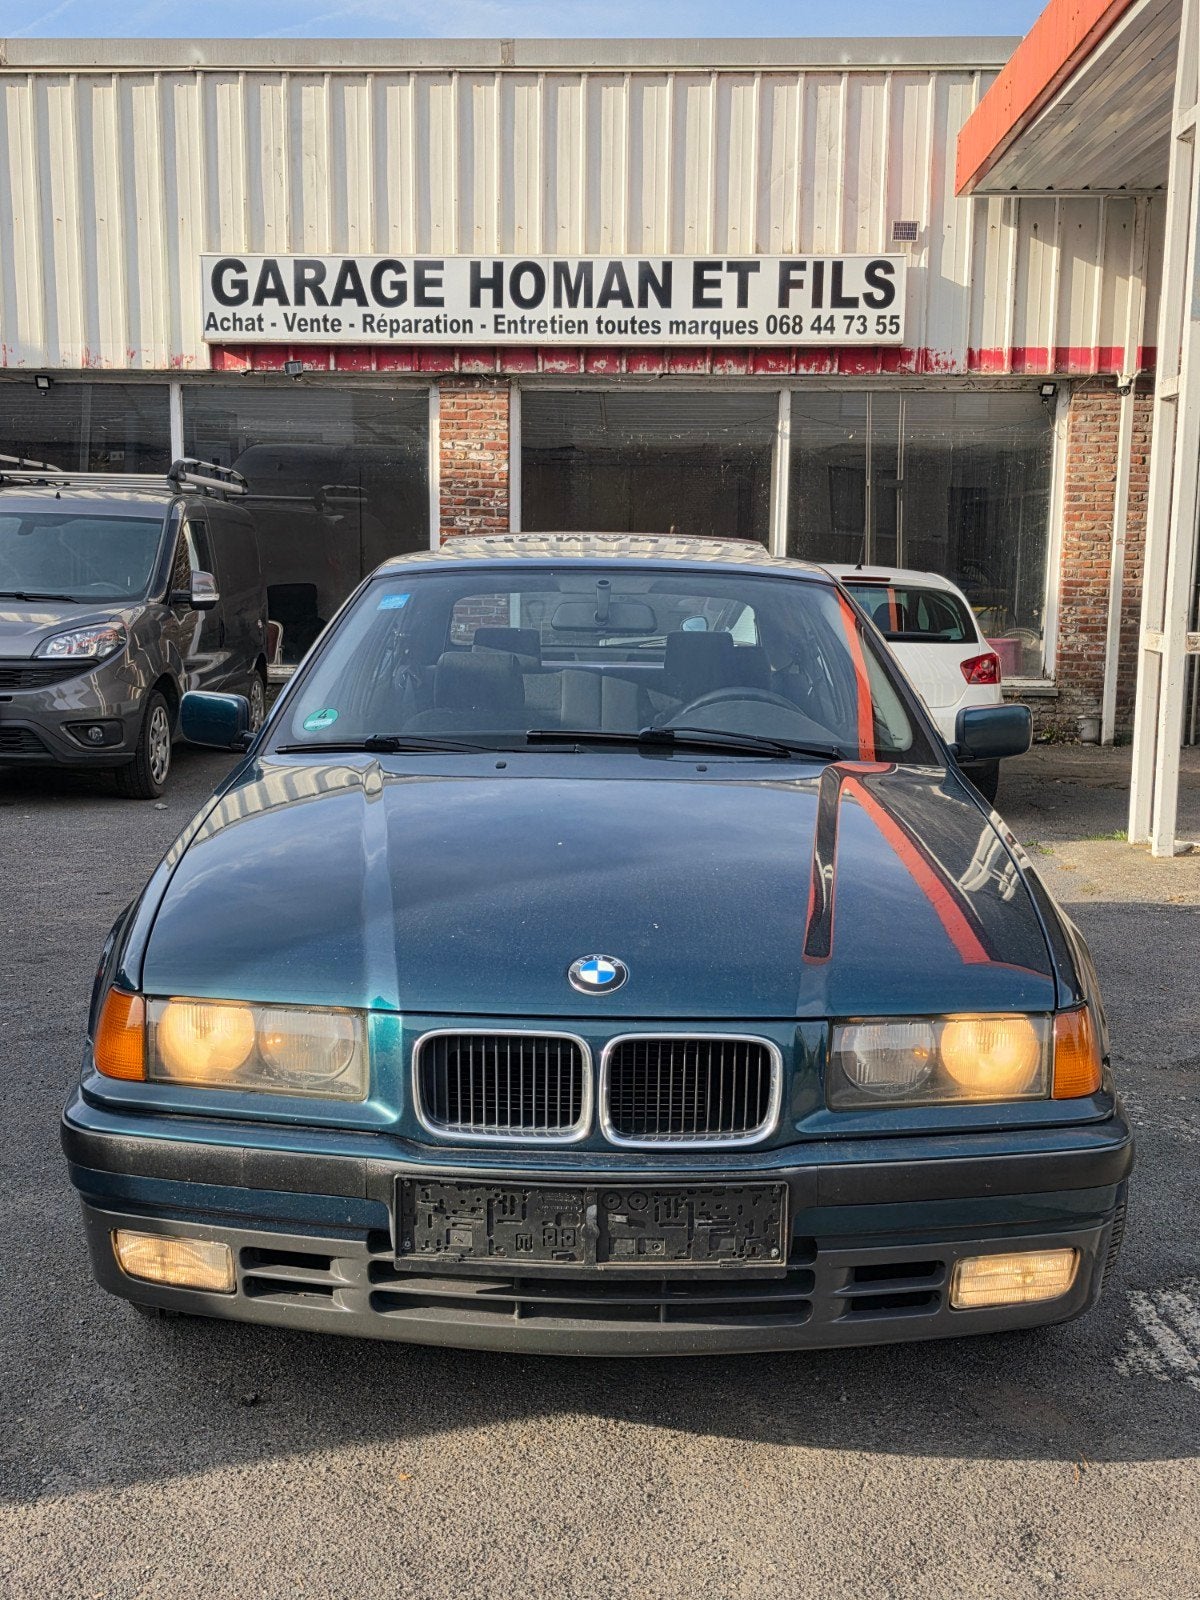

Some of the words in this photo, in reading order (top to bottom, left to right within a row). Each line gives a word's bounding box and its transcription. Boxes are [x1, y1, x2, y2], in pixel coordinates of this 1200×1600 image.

[210, 258, 445, 308] GARAGE
[469, 260, 673, 310] HOMAN
[692, 260, 761, 309] ET
[777, 259, 896, 310] FILS
[204, 311, 265, 333] Achat
[282, 312, 342, 333] Vente
[362, 313, 474, 339] Réparation
[493, 314, 589, 335] Entretien
[595, 315, 662, 335] toutes
[669, 319, 759, 340] marques
[765, 314, 804, 335] 068
[810, 314, 836, 335] 44
[843, 314, 868, 335] 73
[874, 314, 901, 335] 55
[317, 709, 328, 719] 4
